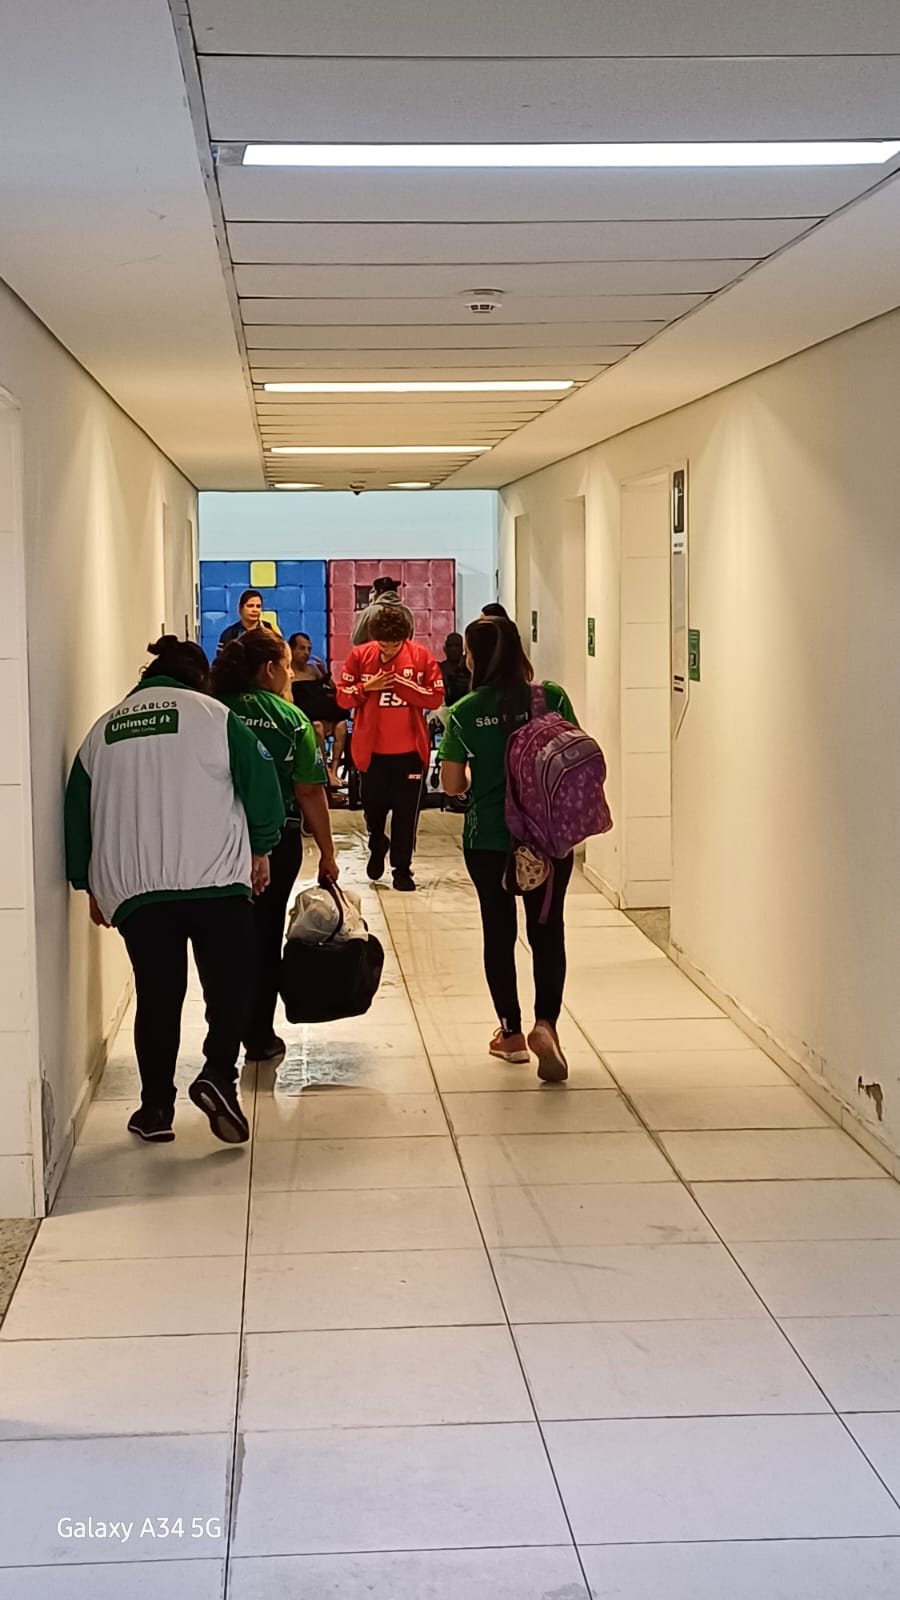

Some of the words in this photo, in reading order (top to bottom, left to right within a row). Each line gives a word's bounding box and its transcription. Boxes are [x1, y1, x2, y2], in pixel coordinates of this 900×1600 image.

[132, 701, 177, 712] CARLOS
[111, 716, 156, 731] Unimed
[475, 716, 499, 727] São
